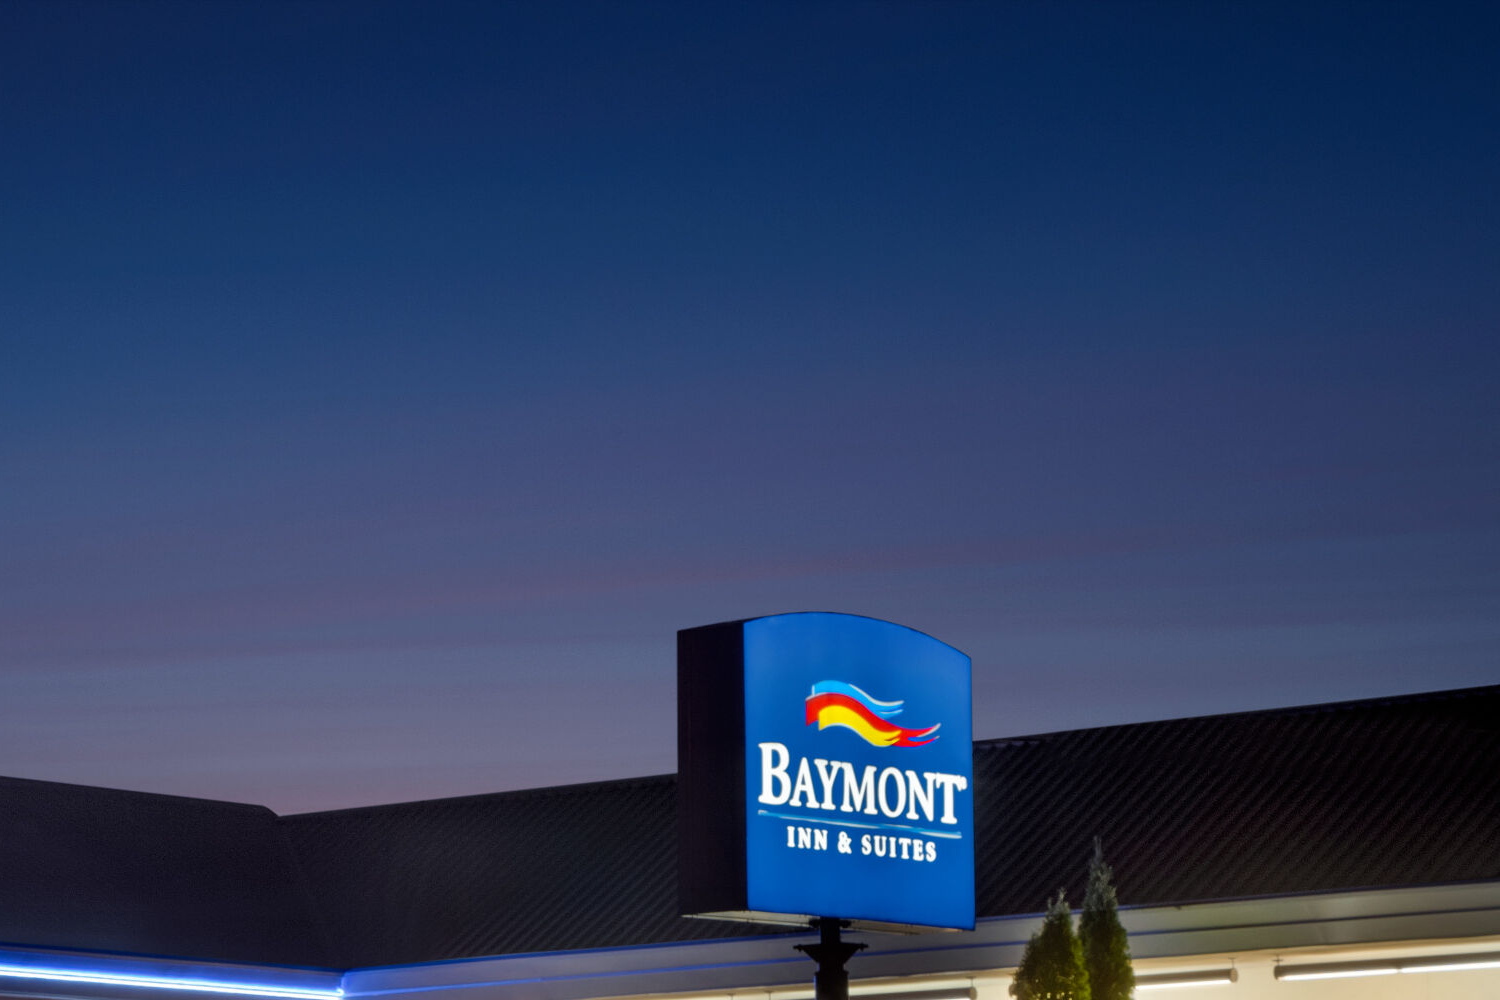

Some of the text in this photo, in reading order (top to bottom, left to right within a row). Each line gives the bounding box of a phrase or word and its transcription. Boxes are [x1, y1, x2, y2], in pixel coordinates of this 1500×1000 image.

[758, 742, 967, 825] BAYMONT
[787, 826, 937, 863] INN & SUITES
